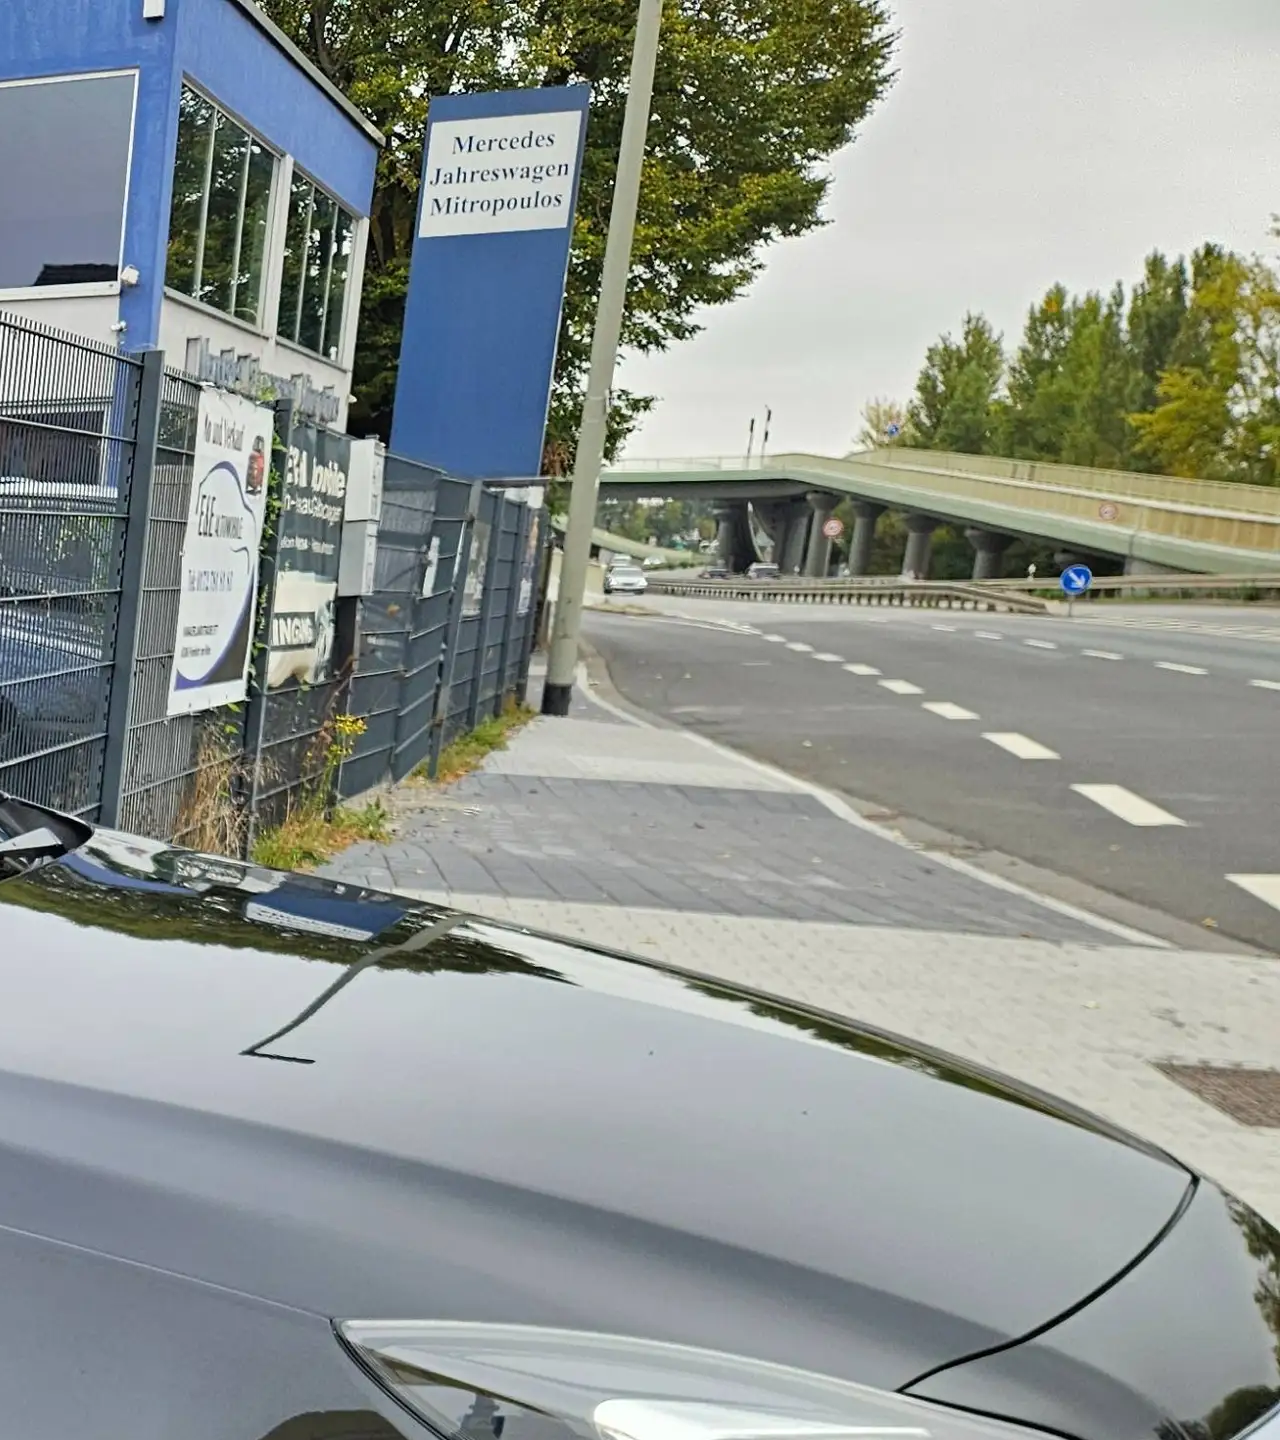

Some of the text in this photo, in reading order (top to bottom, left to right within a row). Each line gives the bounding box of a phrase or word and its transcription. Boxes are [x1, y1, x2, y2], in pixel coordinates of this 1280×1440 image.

[452, 130, 556, 155] Mercedes
[429, 162, 569, 187] Jahreswagen
[430, 190, 563, 216] Mitropoulos
